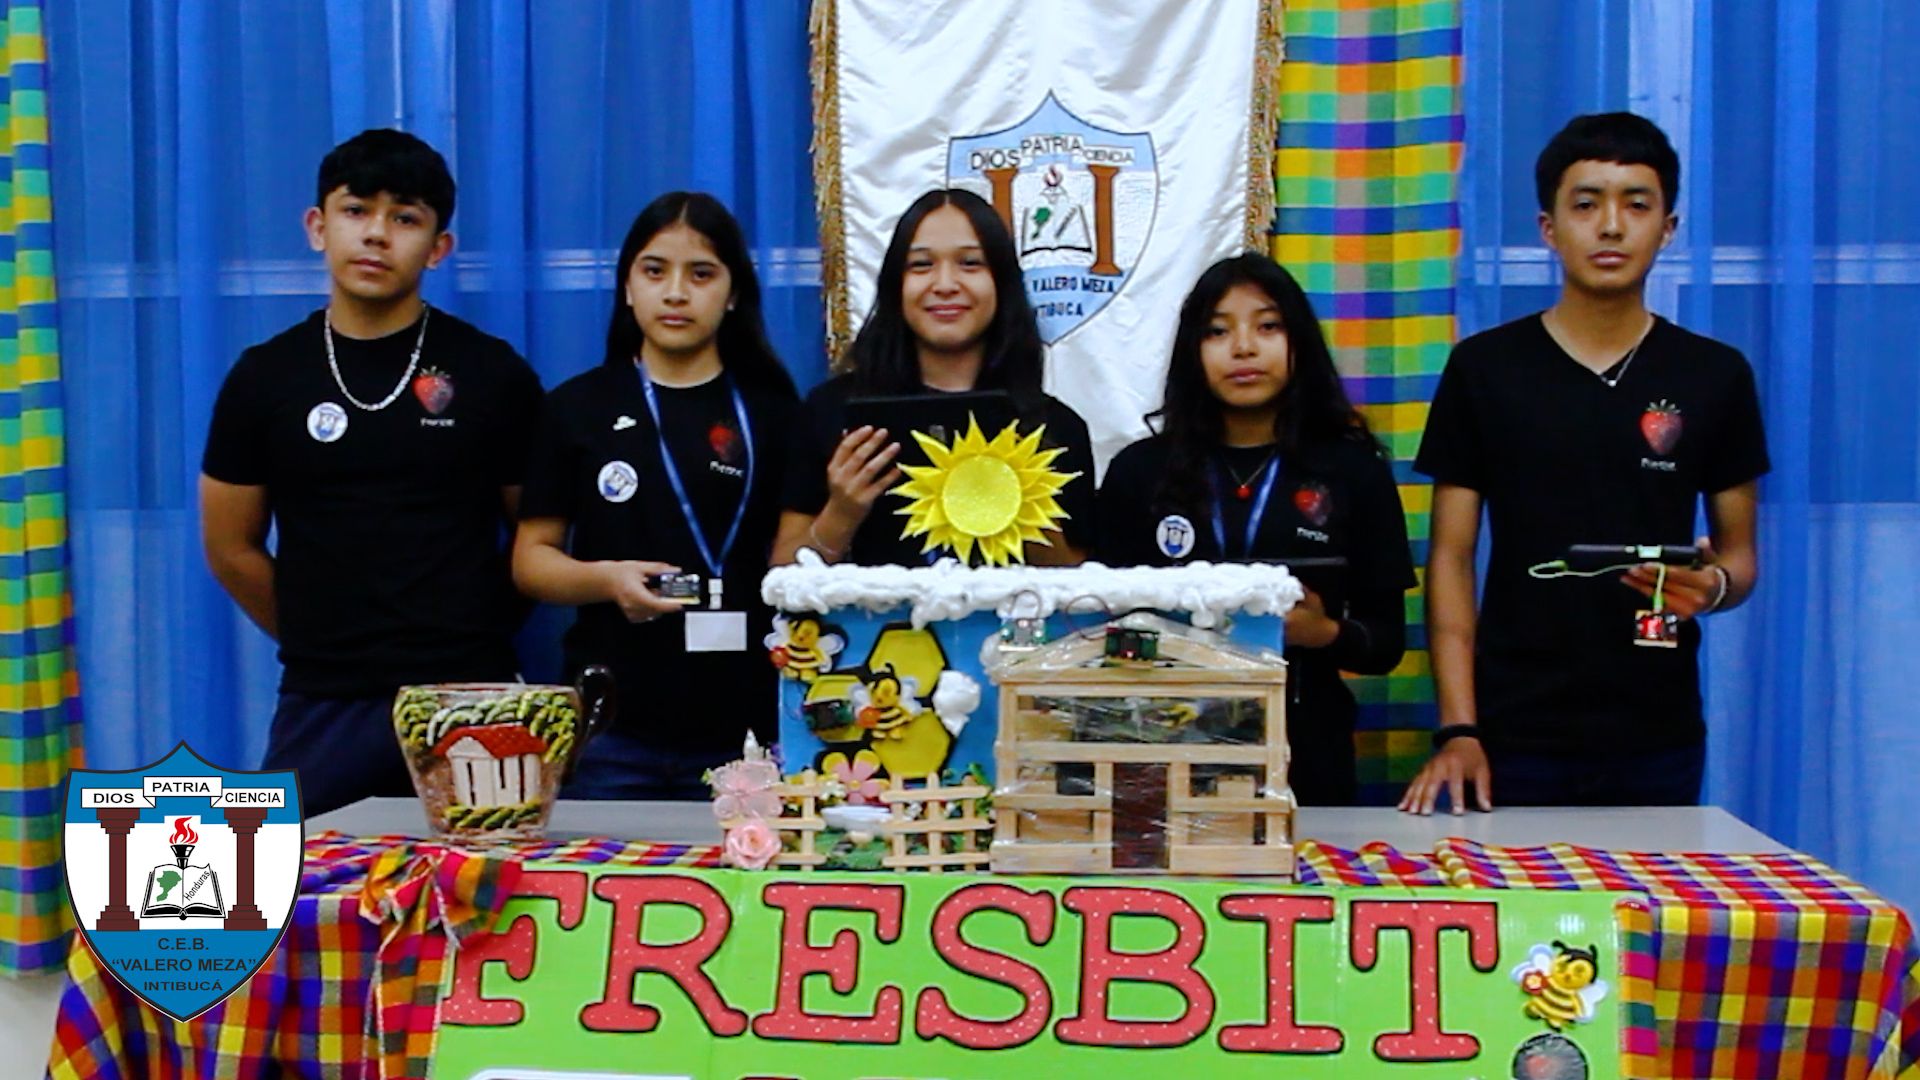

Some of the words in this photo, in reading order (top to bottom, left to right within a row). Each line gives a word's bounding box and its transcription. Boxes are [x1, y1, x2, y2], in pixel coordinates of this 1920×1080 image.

[971, 150, 1021, 170] DIOS
[1021, 136, 1082, 154] PATRIA
[1083, 149, 1133, 162] CIENCIA
[1081, 277, 1114, 292] MEZA
[440, 868, 1499, 1062] FRESBIT
